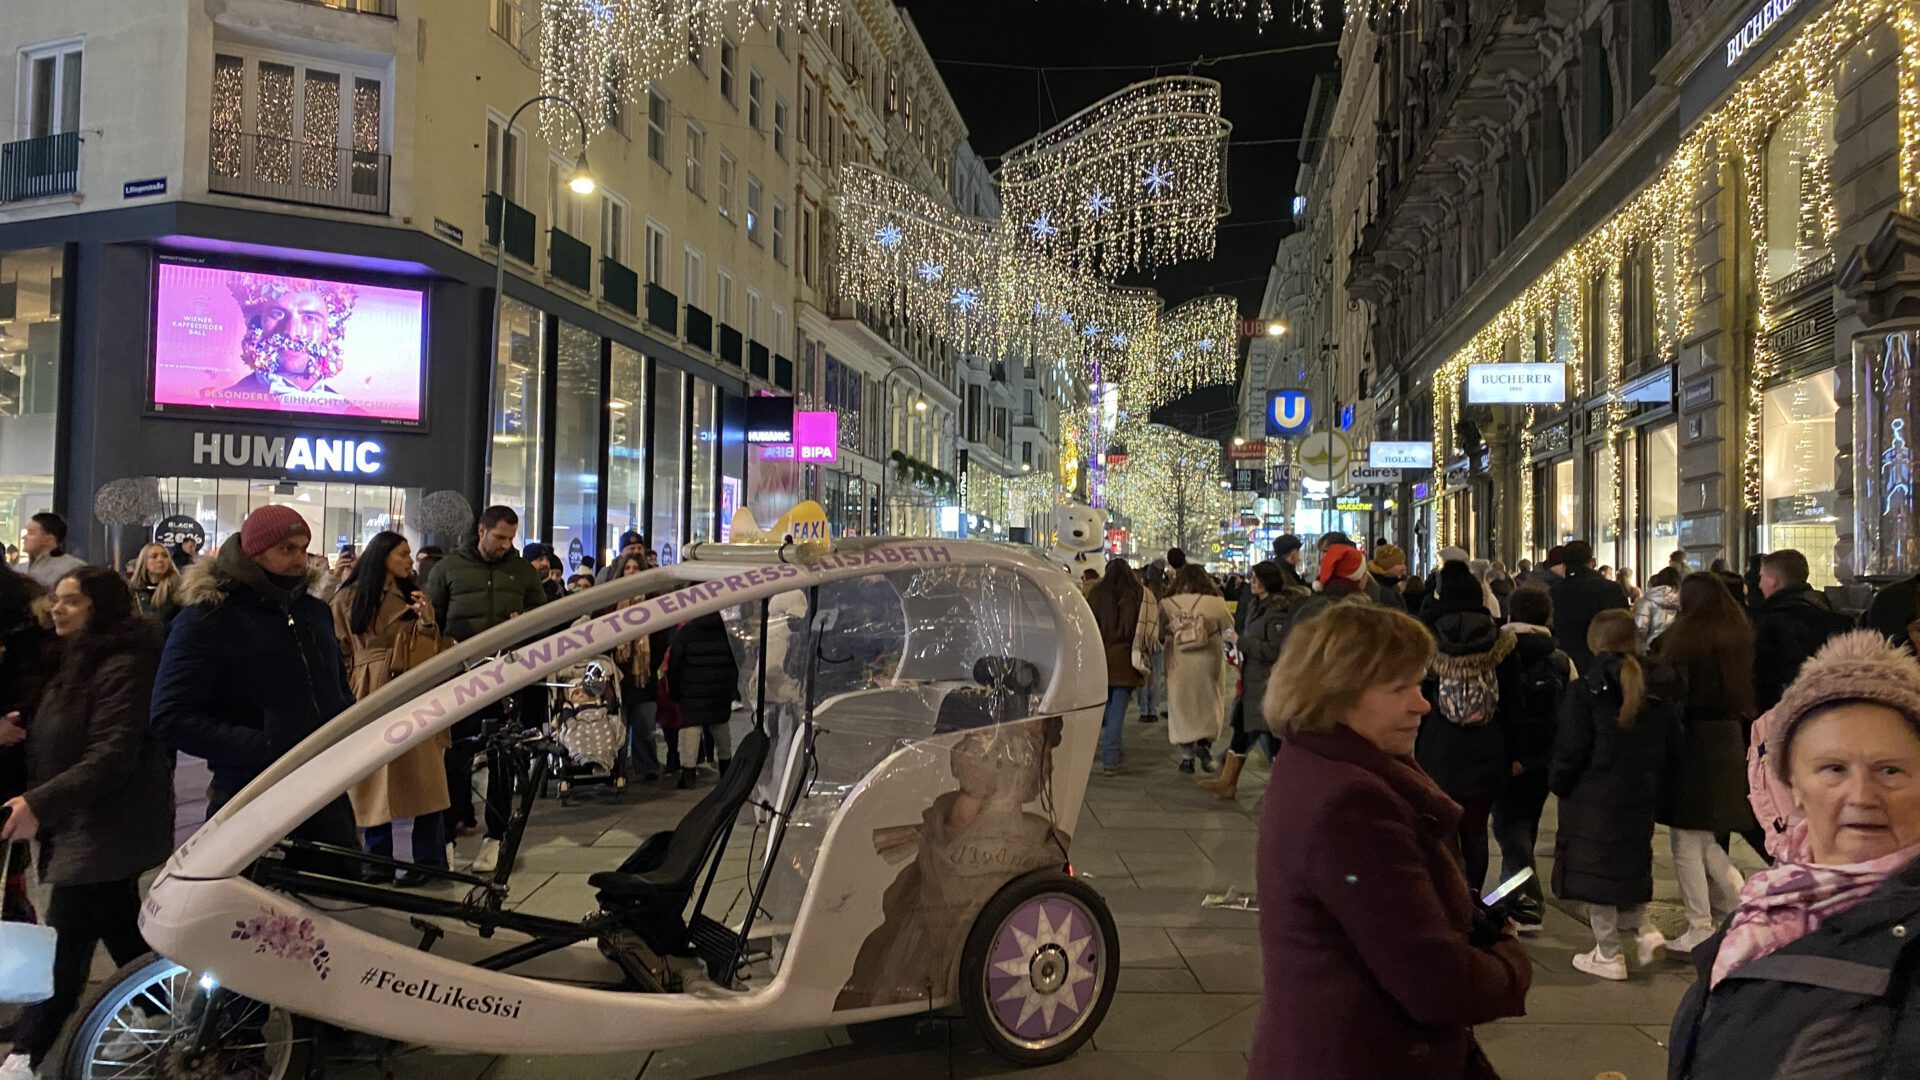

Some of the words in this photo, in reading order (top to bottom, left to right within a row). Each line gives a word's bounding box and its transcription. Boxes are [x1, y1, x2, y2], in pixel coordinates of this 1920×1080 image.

[183, 316, 213, 324] WIENER
[1481, 374, 1552, 385] BUCHERER
[204, 389, 269, 401] BESONDERE
[1274, 396, 1305, 428] U
[748, 431, 791, 442] HUMANIC
[193, 432, 382, 473] HUMANIC
[801, 446, 833, 459] BIPA
[1384, 455, 1417, 463] ROLEX
[1273, 467, 1289, 480] WC
[1351, 466, 1399, 478] claire's
[1336, 503, 1374, 511] wutscher
[168, 521, 194, 529] BLACK
[793, 520, 825, 539] FAXI
[157, 532, 203, 545] -20%
[384, 701, 447, 745] ON
[453, 666, 506, 707] MY
[518, 623, 594, 671] WAY
[602, 606, 651, 634] TO
[656, 563, 798, 615] EMPRESS
[806, 545, 952, 573] ELISABETH
[360, 967, 523, 1019] #FeelLikeSisi
